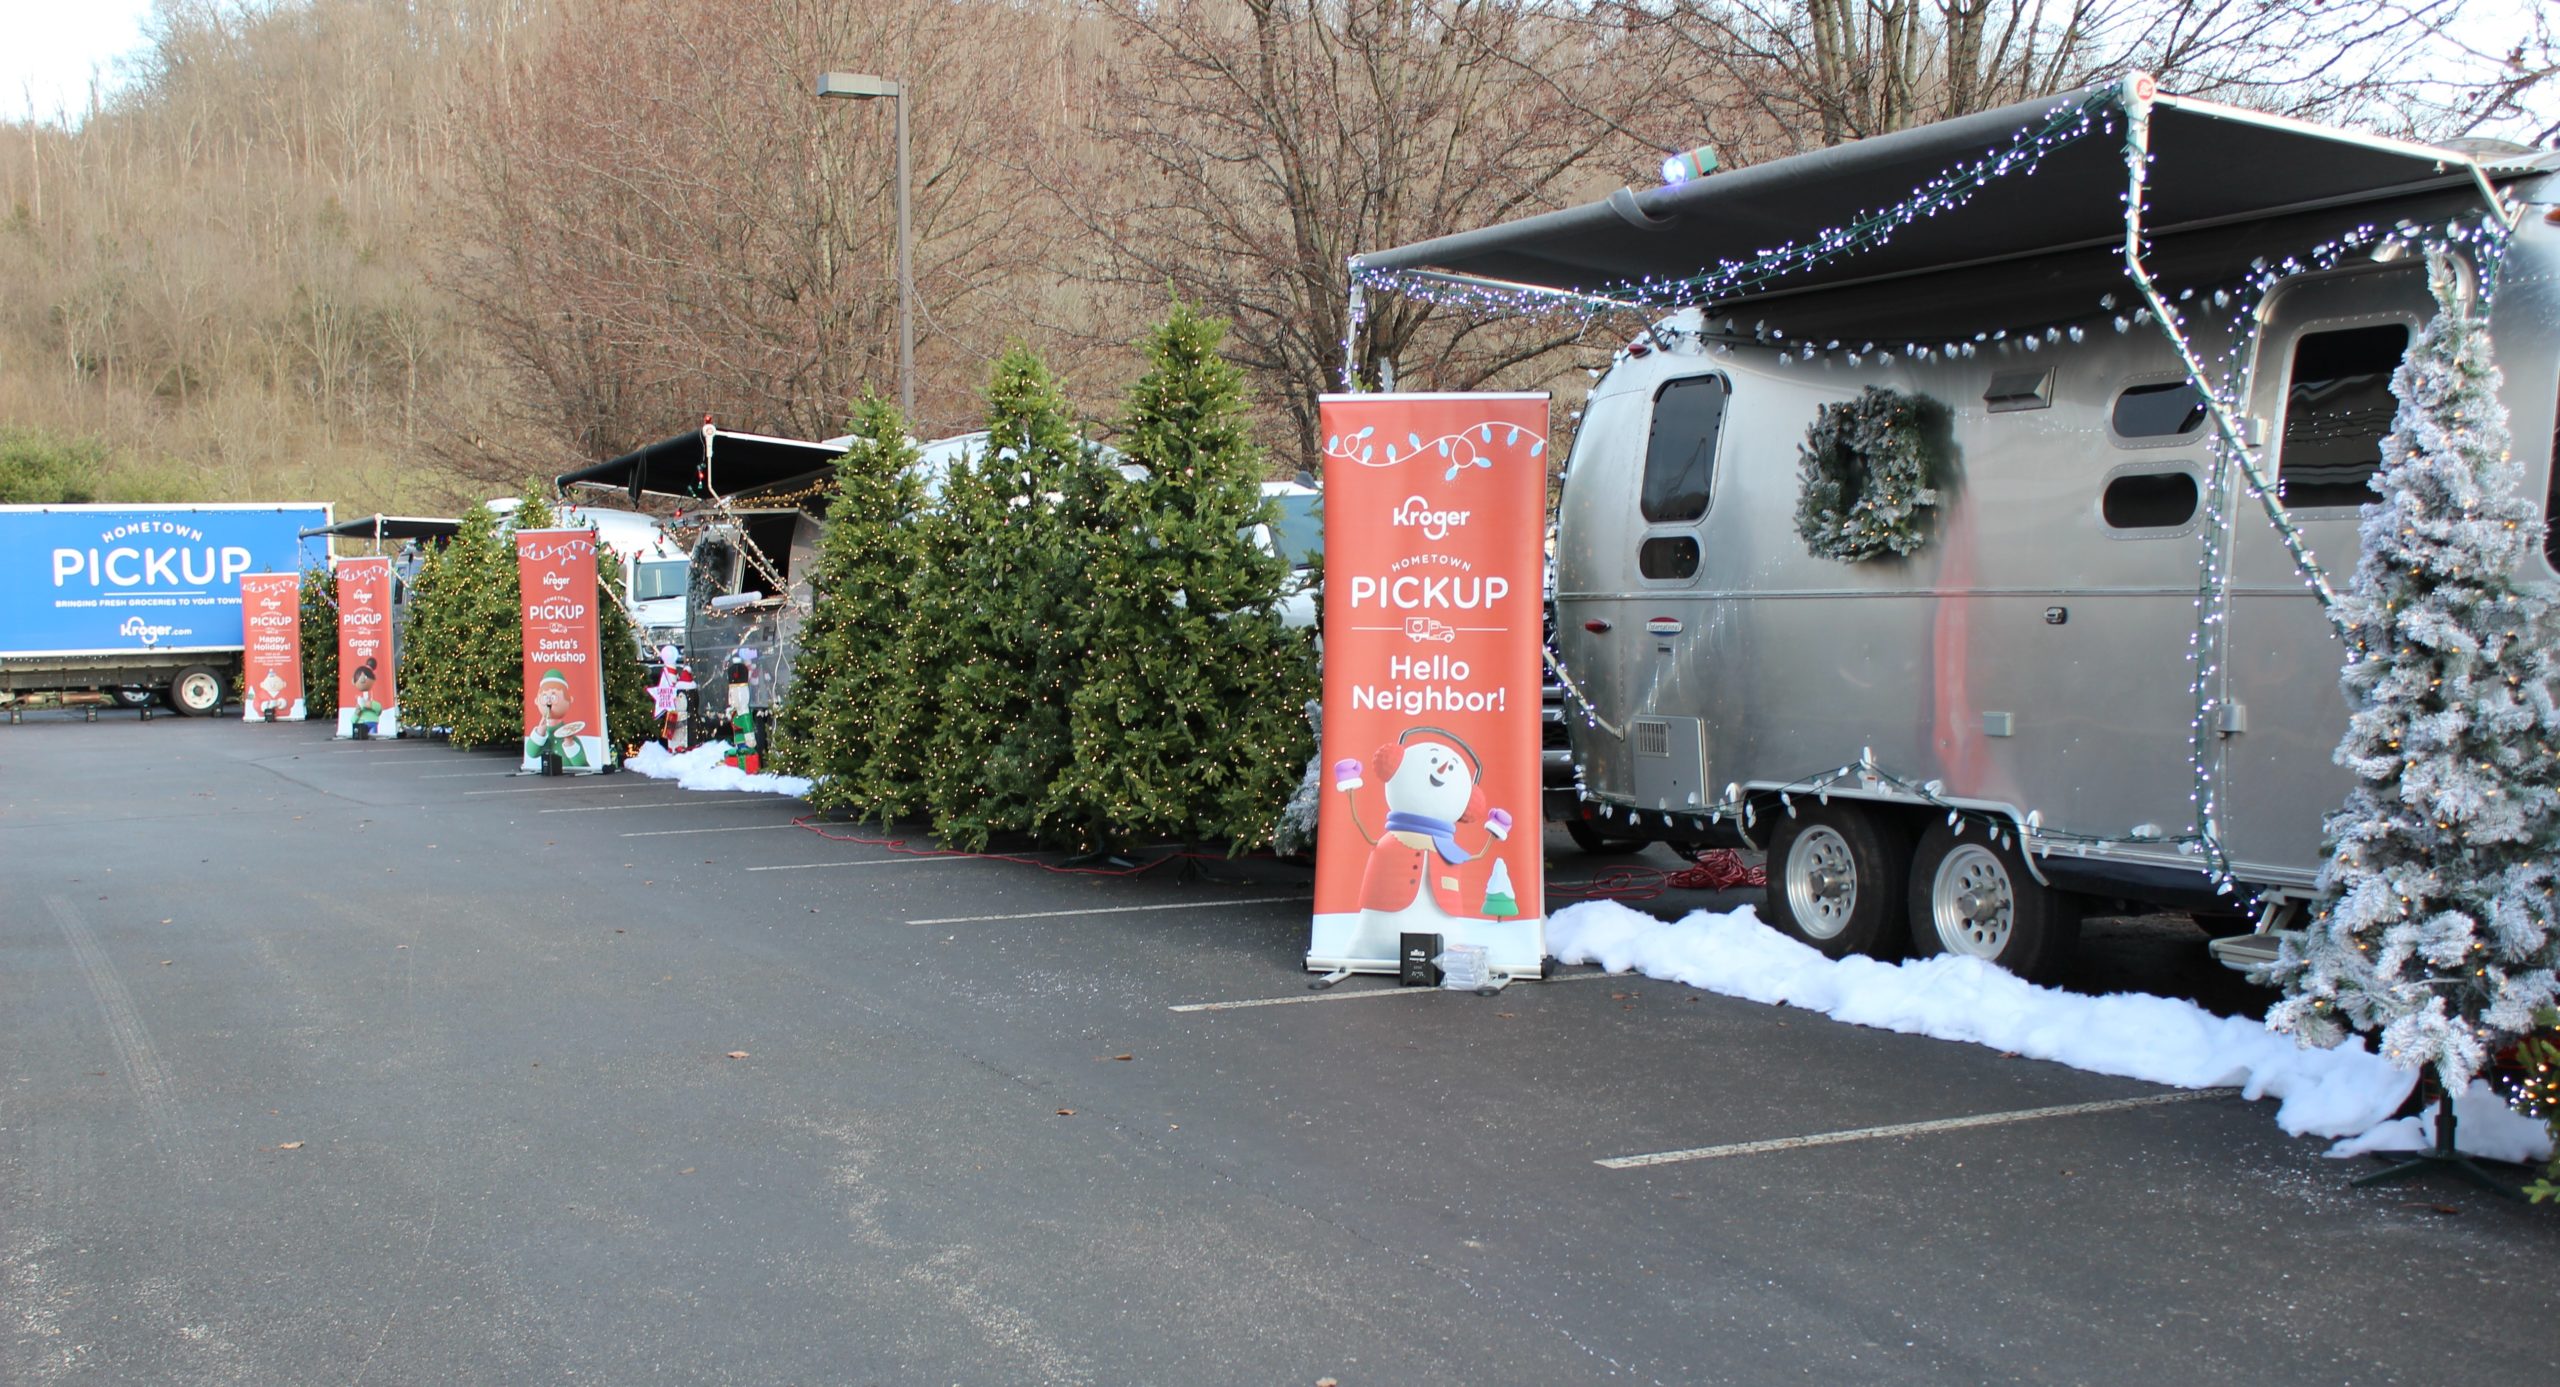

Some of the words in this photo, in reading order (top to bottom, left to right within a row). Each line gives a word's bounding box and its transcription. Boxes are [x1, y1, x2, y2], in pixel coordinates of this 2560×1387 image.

[1393, 495, 1470, 540] Kroger
[102, 521, 203, 543] HOMETOWN
[53, 547, 252, 587] PICKUP
[1391, 554, 1472, 572] HOMETOWN
[543, 571, 570, 591] Kroger
[1351, 576, 1509, 609] PICKUP
[55, 600, 97, 608] BRINGING
[99, 599, 127, 607] FRESH
[129, 598, 176, 606] GROCERIES
[179, 598, 190, 606] TO
[192, 597, 215, 606] YOUR
[217, 597, 242, 605] TOWN
[343, 613, 382, 625] PICKUP
[529, 604, 584, 620] PICKUP
[250, 616, 292, 626] PICKUP
[259, 635, 285, 644] Happy
[349, 638, 379, 648] Grocery
[539, 639, 578, 650] Santa's
[254, 643, 291, 651] Holidays!
[357, 648, 372, 656] Gift
[531, 651, 586, 664] Workshop
[1390, 655, 1470, 680] Hello
[1352, 685, 1506, 716] Neighbor!
